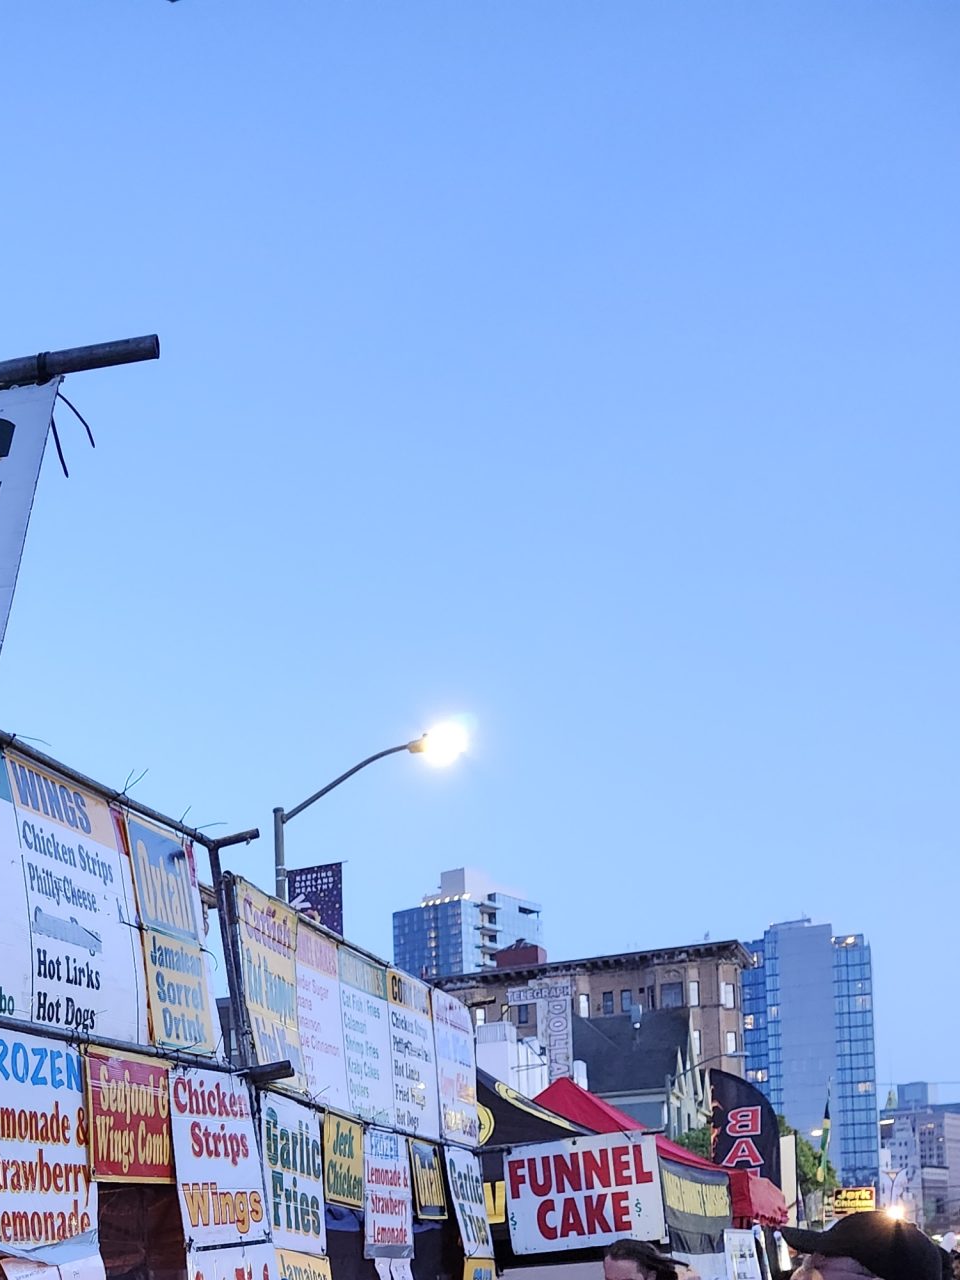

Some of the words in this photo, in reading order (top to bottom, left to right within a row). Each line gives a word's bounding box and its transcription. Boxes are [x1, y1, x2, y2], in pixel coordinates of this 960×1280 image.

[12, 760, 93, 835] WINGS
[22, 819, 77, 869] Chicken
[77, 844, 115, 888] Strips
[136, 839, 195, 933] Oxtail
[295, 877, 334, 888] OAKLAND
[295, 884, 334, 894] HEALTHY
[296, 870, 333, 881] KEEPING
[36, 947, 63, 982] Hot
[150, 935, 203, 978] Jamaican
[36, 991, 62, 1024] Hot
[64, 996, 96, 1032] Dogs
[155, 970, 204, 1012] Sorrel
[508, 986, 571, 1002] TELEGRAPH
[162, 1007, 207, 1043] Drink
[99, 1064, 156, 1125] Seafood
[173, 1076, 250, 1119] Chicken
[74, 1104, 90, 1147] &
[95, 1114, 135, 1174] Wings
[137, 1120, 171, 1167] Comb
[190, 1120, 250, 1168] Strips
[265, 1106, 322, 1181] Garlic
[332, 1120, 355, 1160] Jerk
[326, 1158, 363, 1202] Chicken
[366, 1160, 401, 1188] Lemonade
[448, 1157, 484, 1206] Garlic
[507, 1143, 654, 1200] FUNNEL
[181, 1181, 264, 1234] Wings
[271, 1169, 321, 1238] Fries
[371, 1190, 408, 1224] Strawberry
[458, 1203, 490, 1247] Fries
[536, 1190, 633, 1241] CAKE
[373, 1219, 408, 1245] Lemonade
